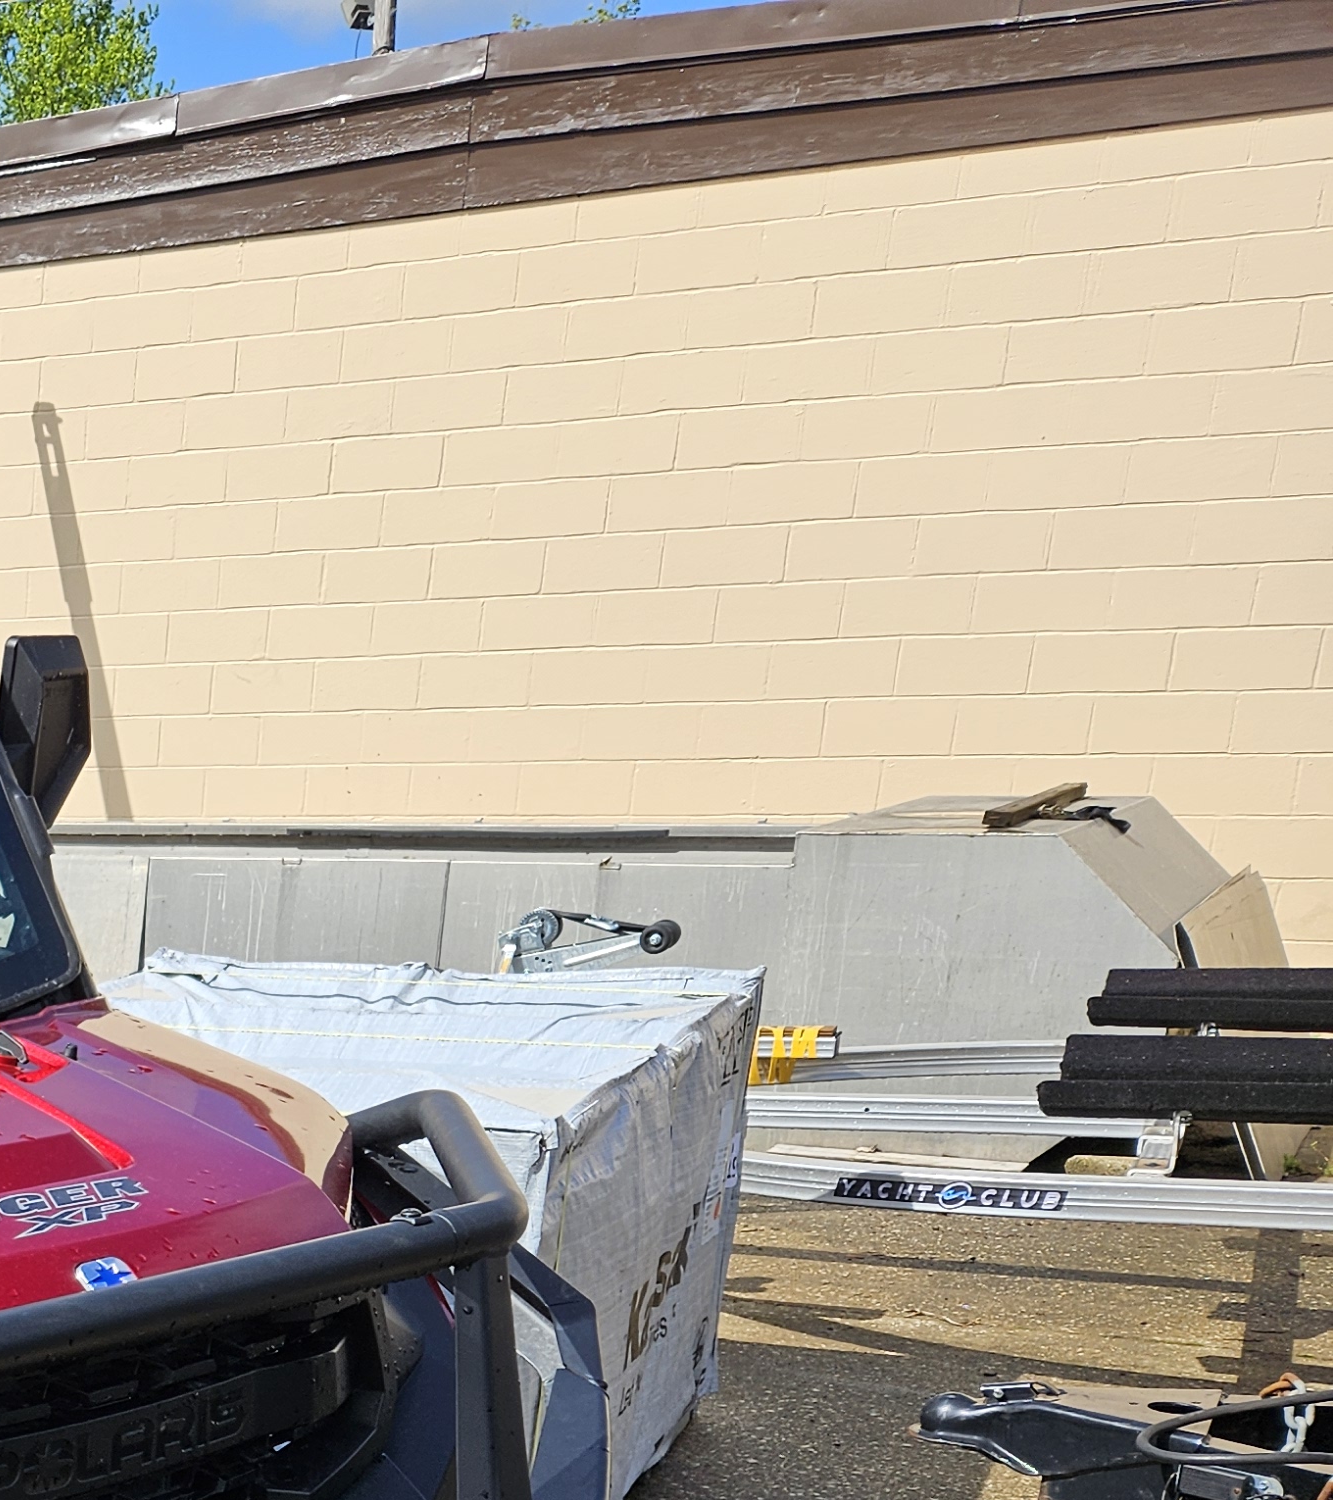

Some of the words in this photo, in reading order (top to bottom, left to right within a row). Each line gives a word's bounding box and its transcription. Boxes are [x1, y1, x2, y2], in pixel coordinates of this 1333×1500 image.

[840, 1178, 934, 1202] YACHT
[979, 1189, 1063, 1210] CLUB
[13, 1200, 142, 1239] XP
